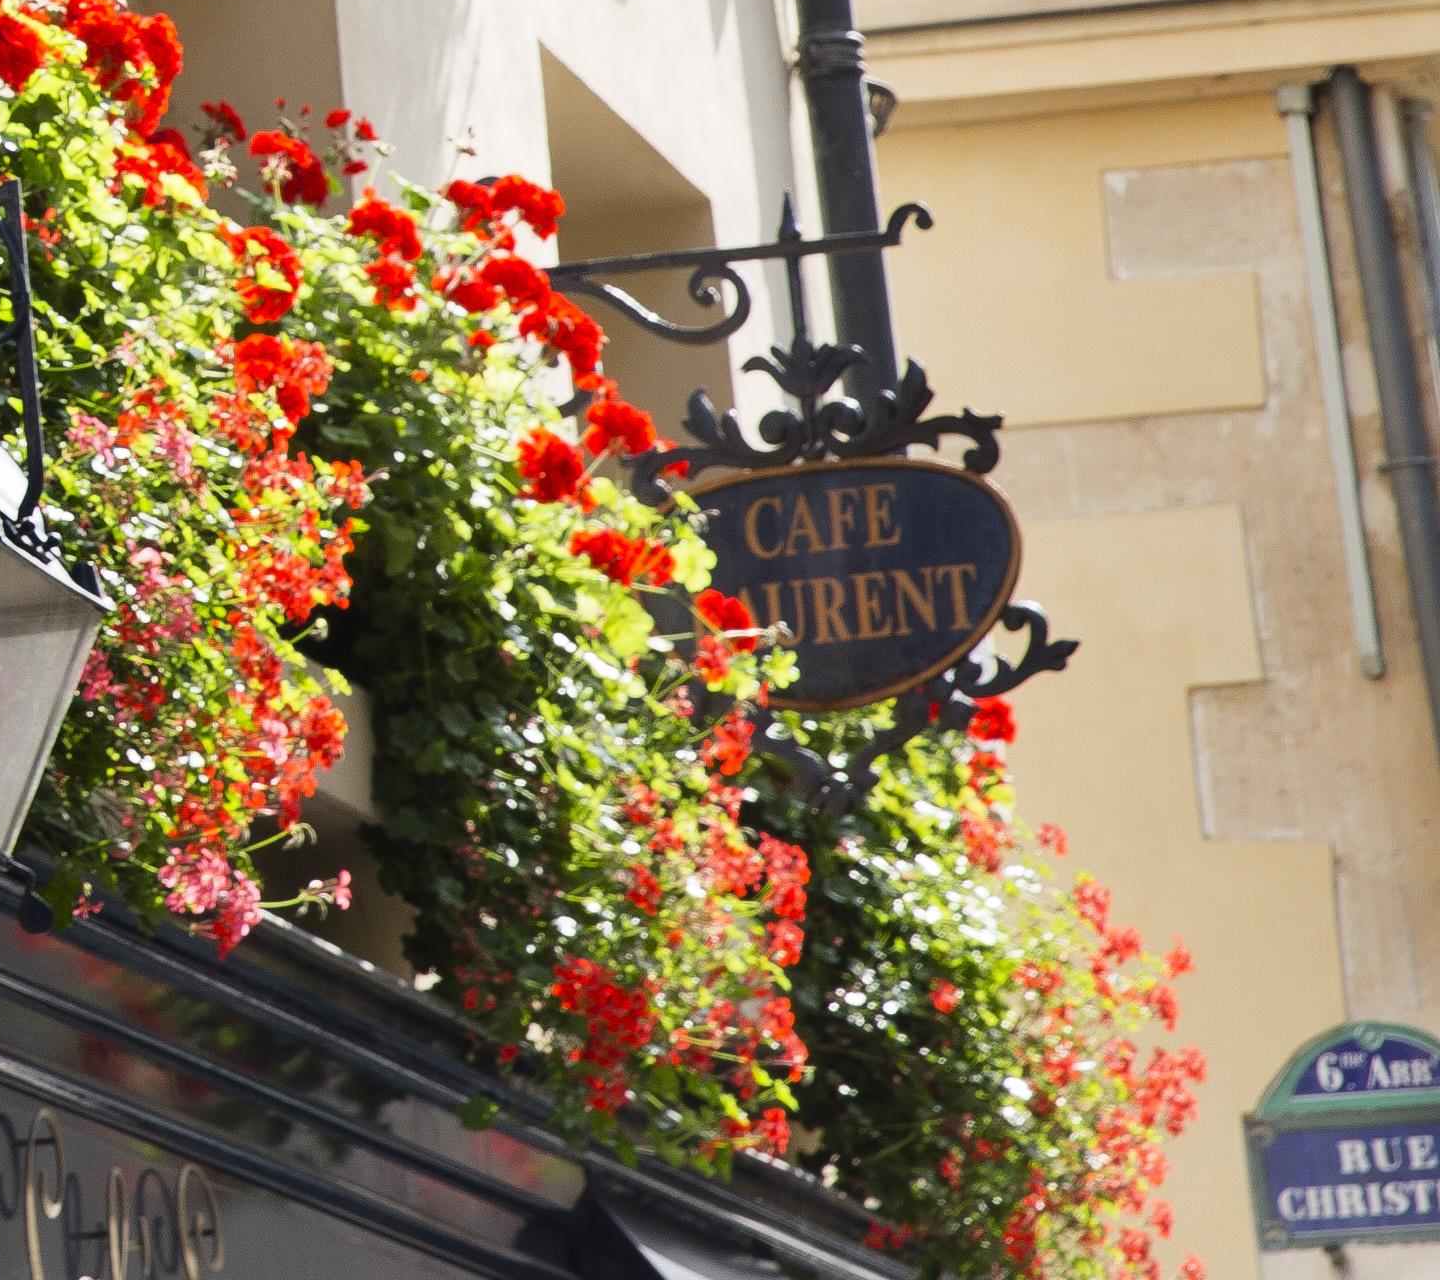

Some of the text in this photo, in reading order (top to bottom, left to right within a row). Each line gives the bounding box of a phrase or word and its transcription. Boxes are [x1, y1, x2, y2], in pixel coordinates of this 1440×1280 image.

[743, 483, 902, 560] CAFE
[693, 562, 978, 656] URENT
[1336, 1134, 1439, 1175] RUE
[1277, 1178, 1440, 1221] CHRIST
